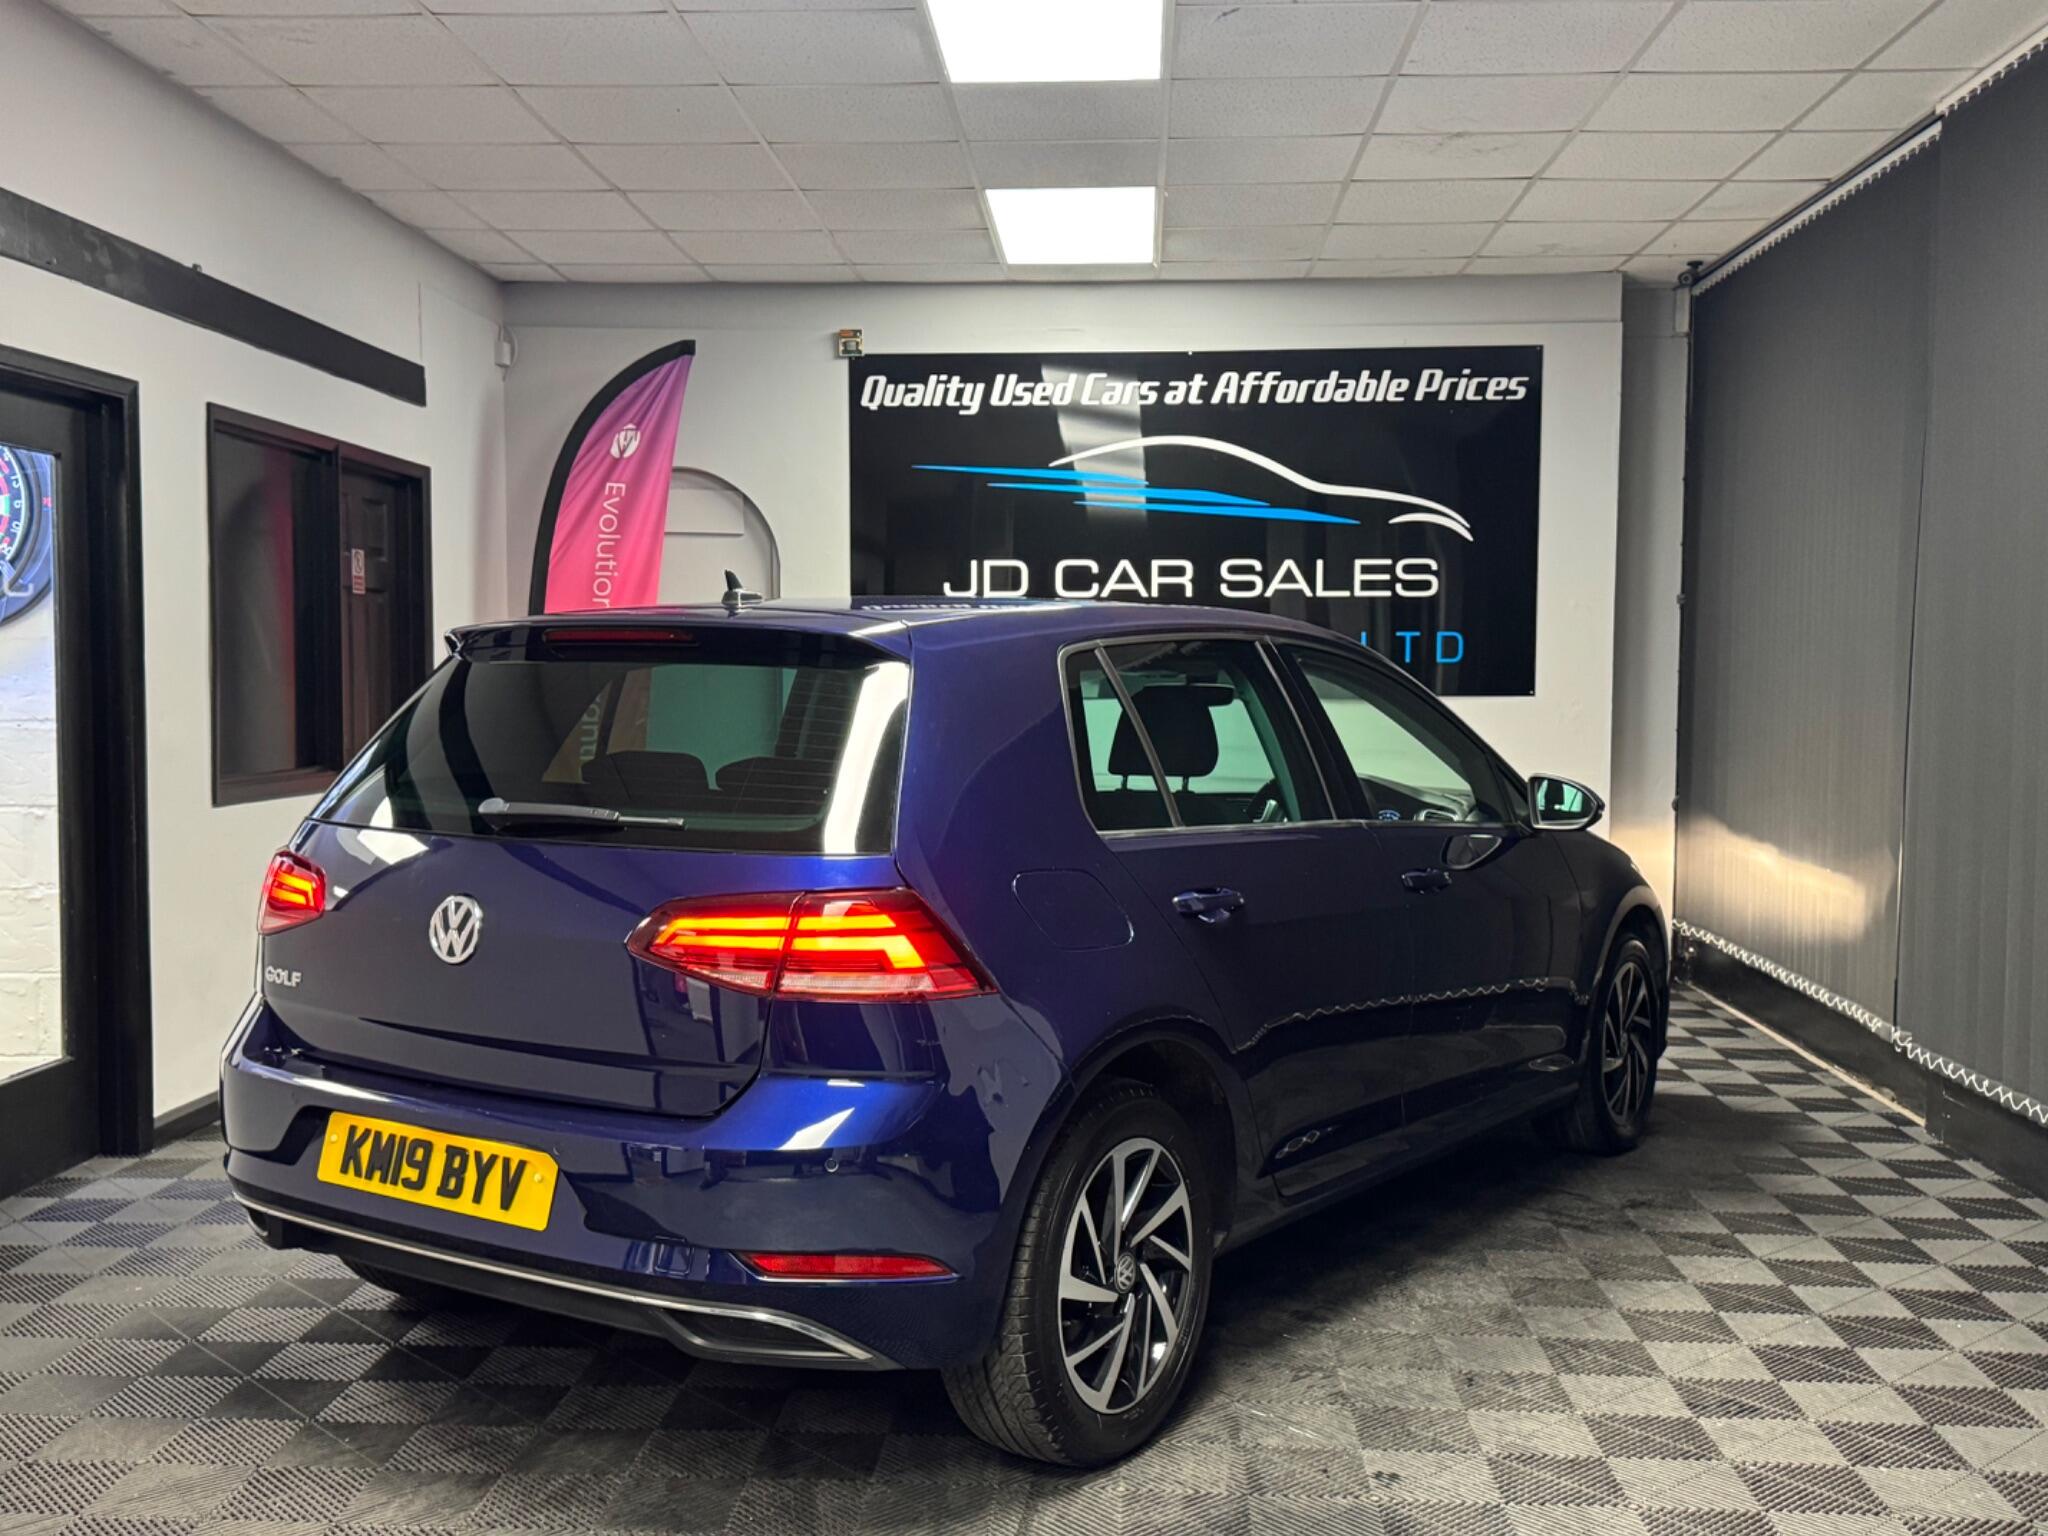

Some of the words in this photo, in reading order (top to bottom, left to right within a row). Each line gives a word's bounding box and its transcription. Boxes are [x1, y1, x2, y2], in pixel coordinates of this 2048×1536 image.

[860, 374, 986, 415] Quality
[990, 373, 1077, 406] Used
[1081, 372, 1160, 405] Cars
[1163, 372, 1208, 405] at
[1210, 370, 1410, 404] Affordable
[1415, 368, 1530, 401] Prices
[943, 558, 1029, 598] JD
[1055, 558, 1193, 598] CAR
[1219, 558, 1440, 598] SALES
[265, 965, 302, 987] GOLF
[339, 1124, 434, 1191] KM19
[436, 1144, 527, 1212] BYV
